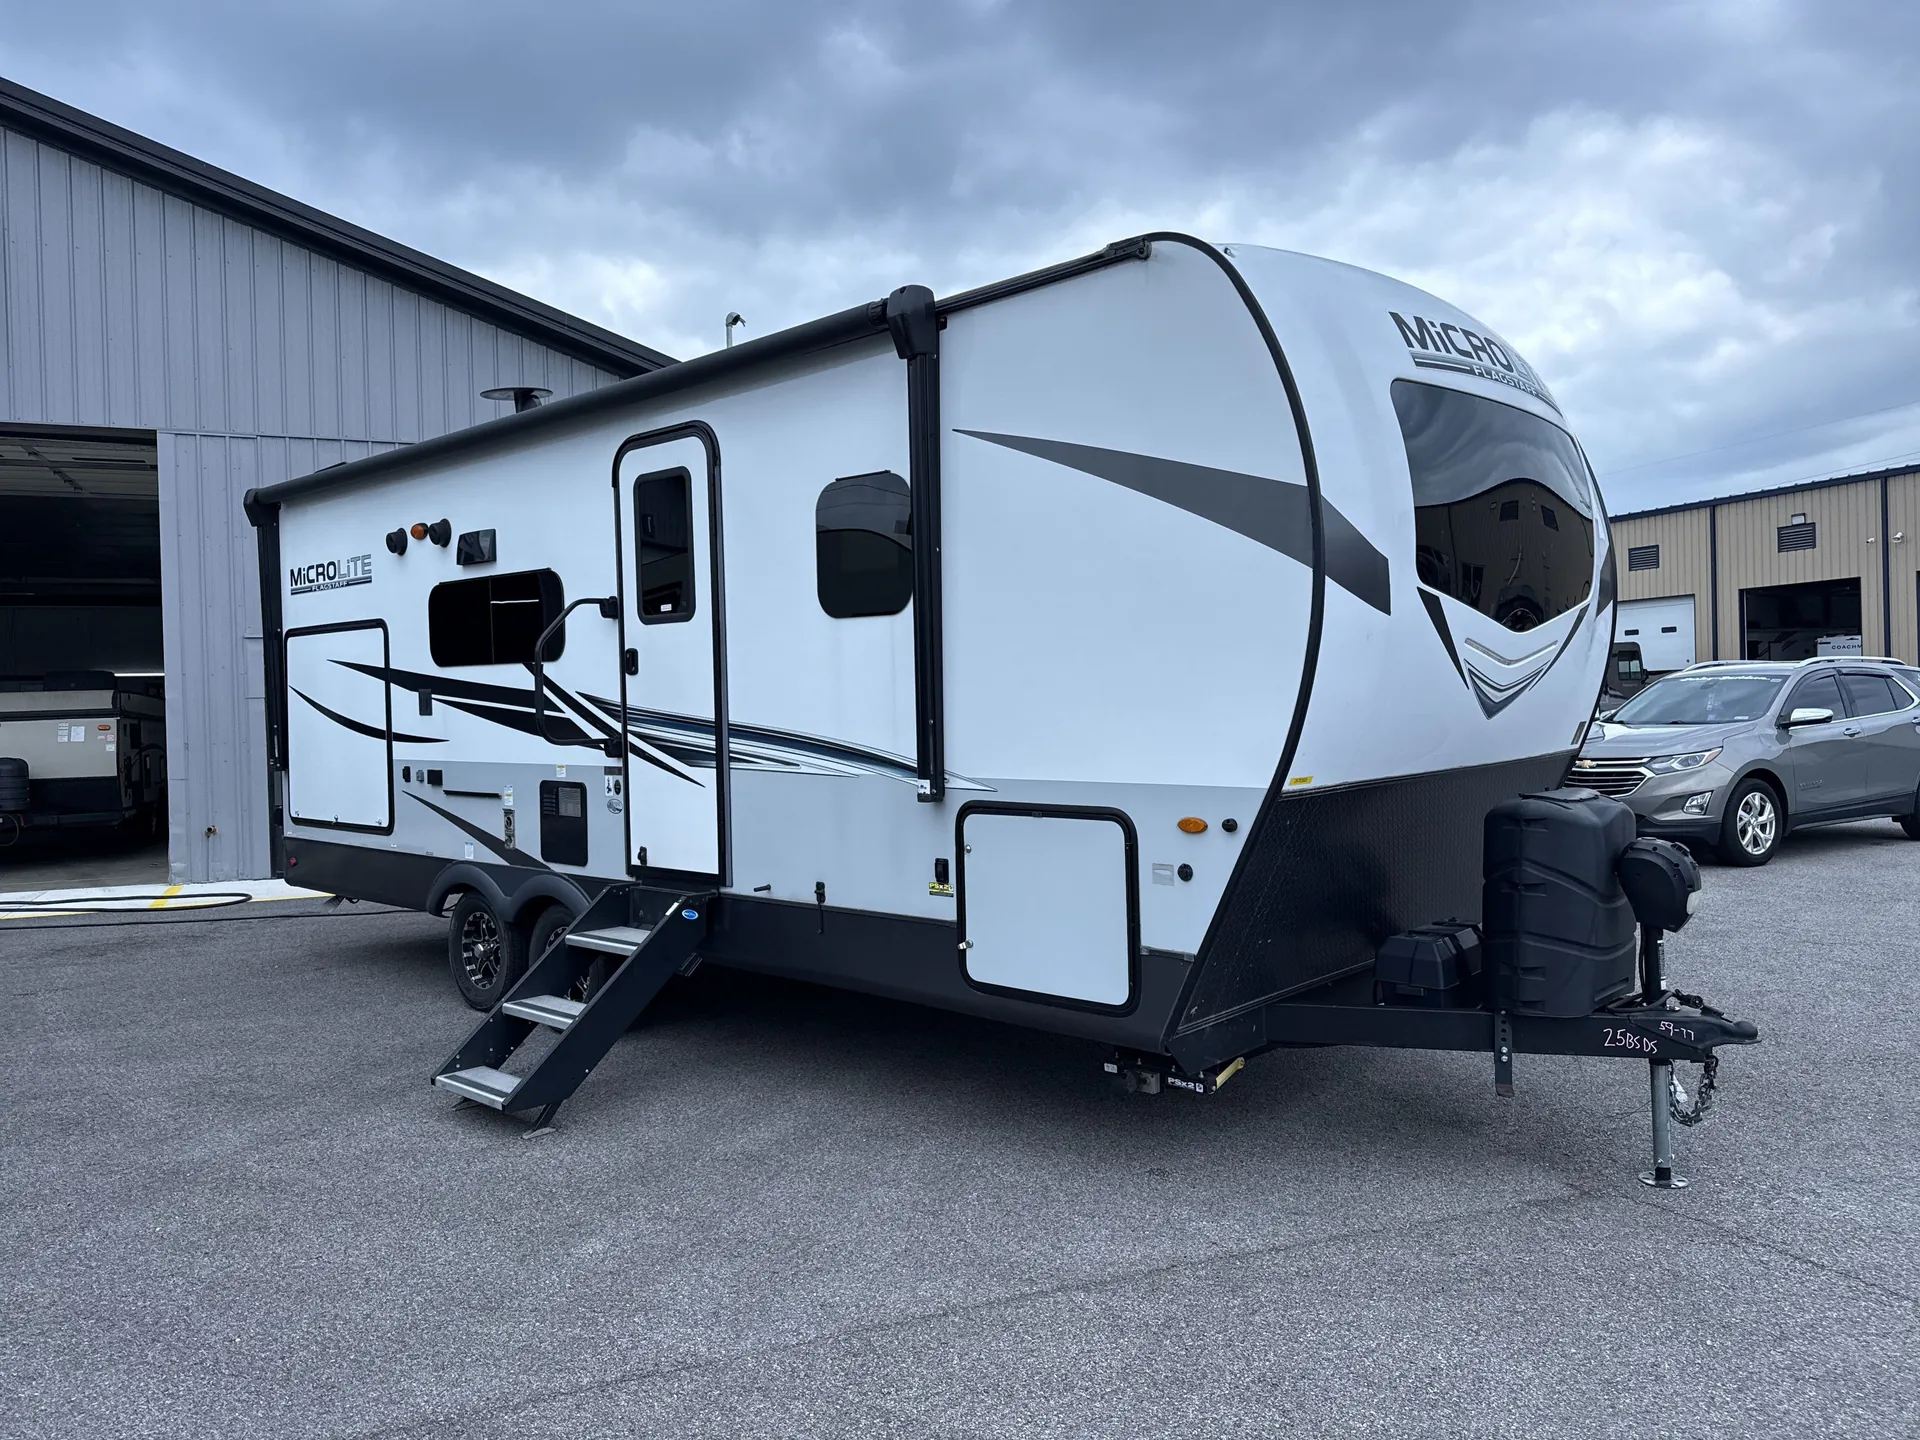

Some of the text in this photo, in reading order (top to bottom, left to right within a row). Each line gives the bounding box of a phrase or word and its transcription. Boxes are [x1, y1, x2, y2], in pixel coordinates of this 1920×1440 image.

[1474, 366, 1538, 397] FLAGSTAFF
[311, 580, 348, 592] FLAGSTAFF
[1659, 1021, 1694, 1041] 59-77
